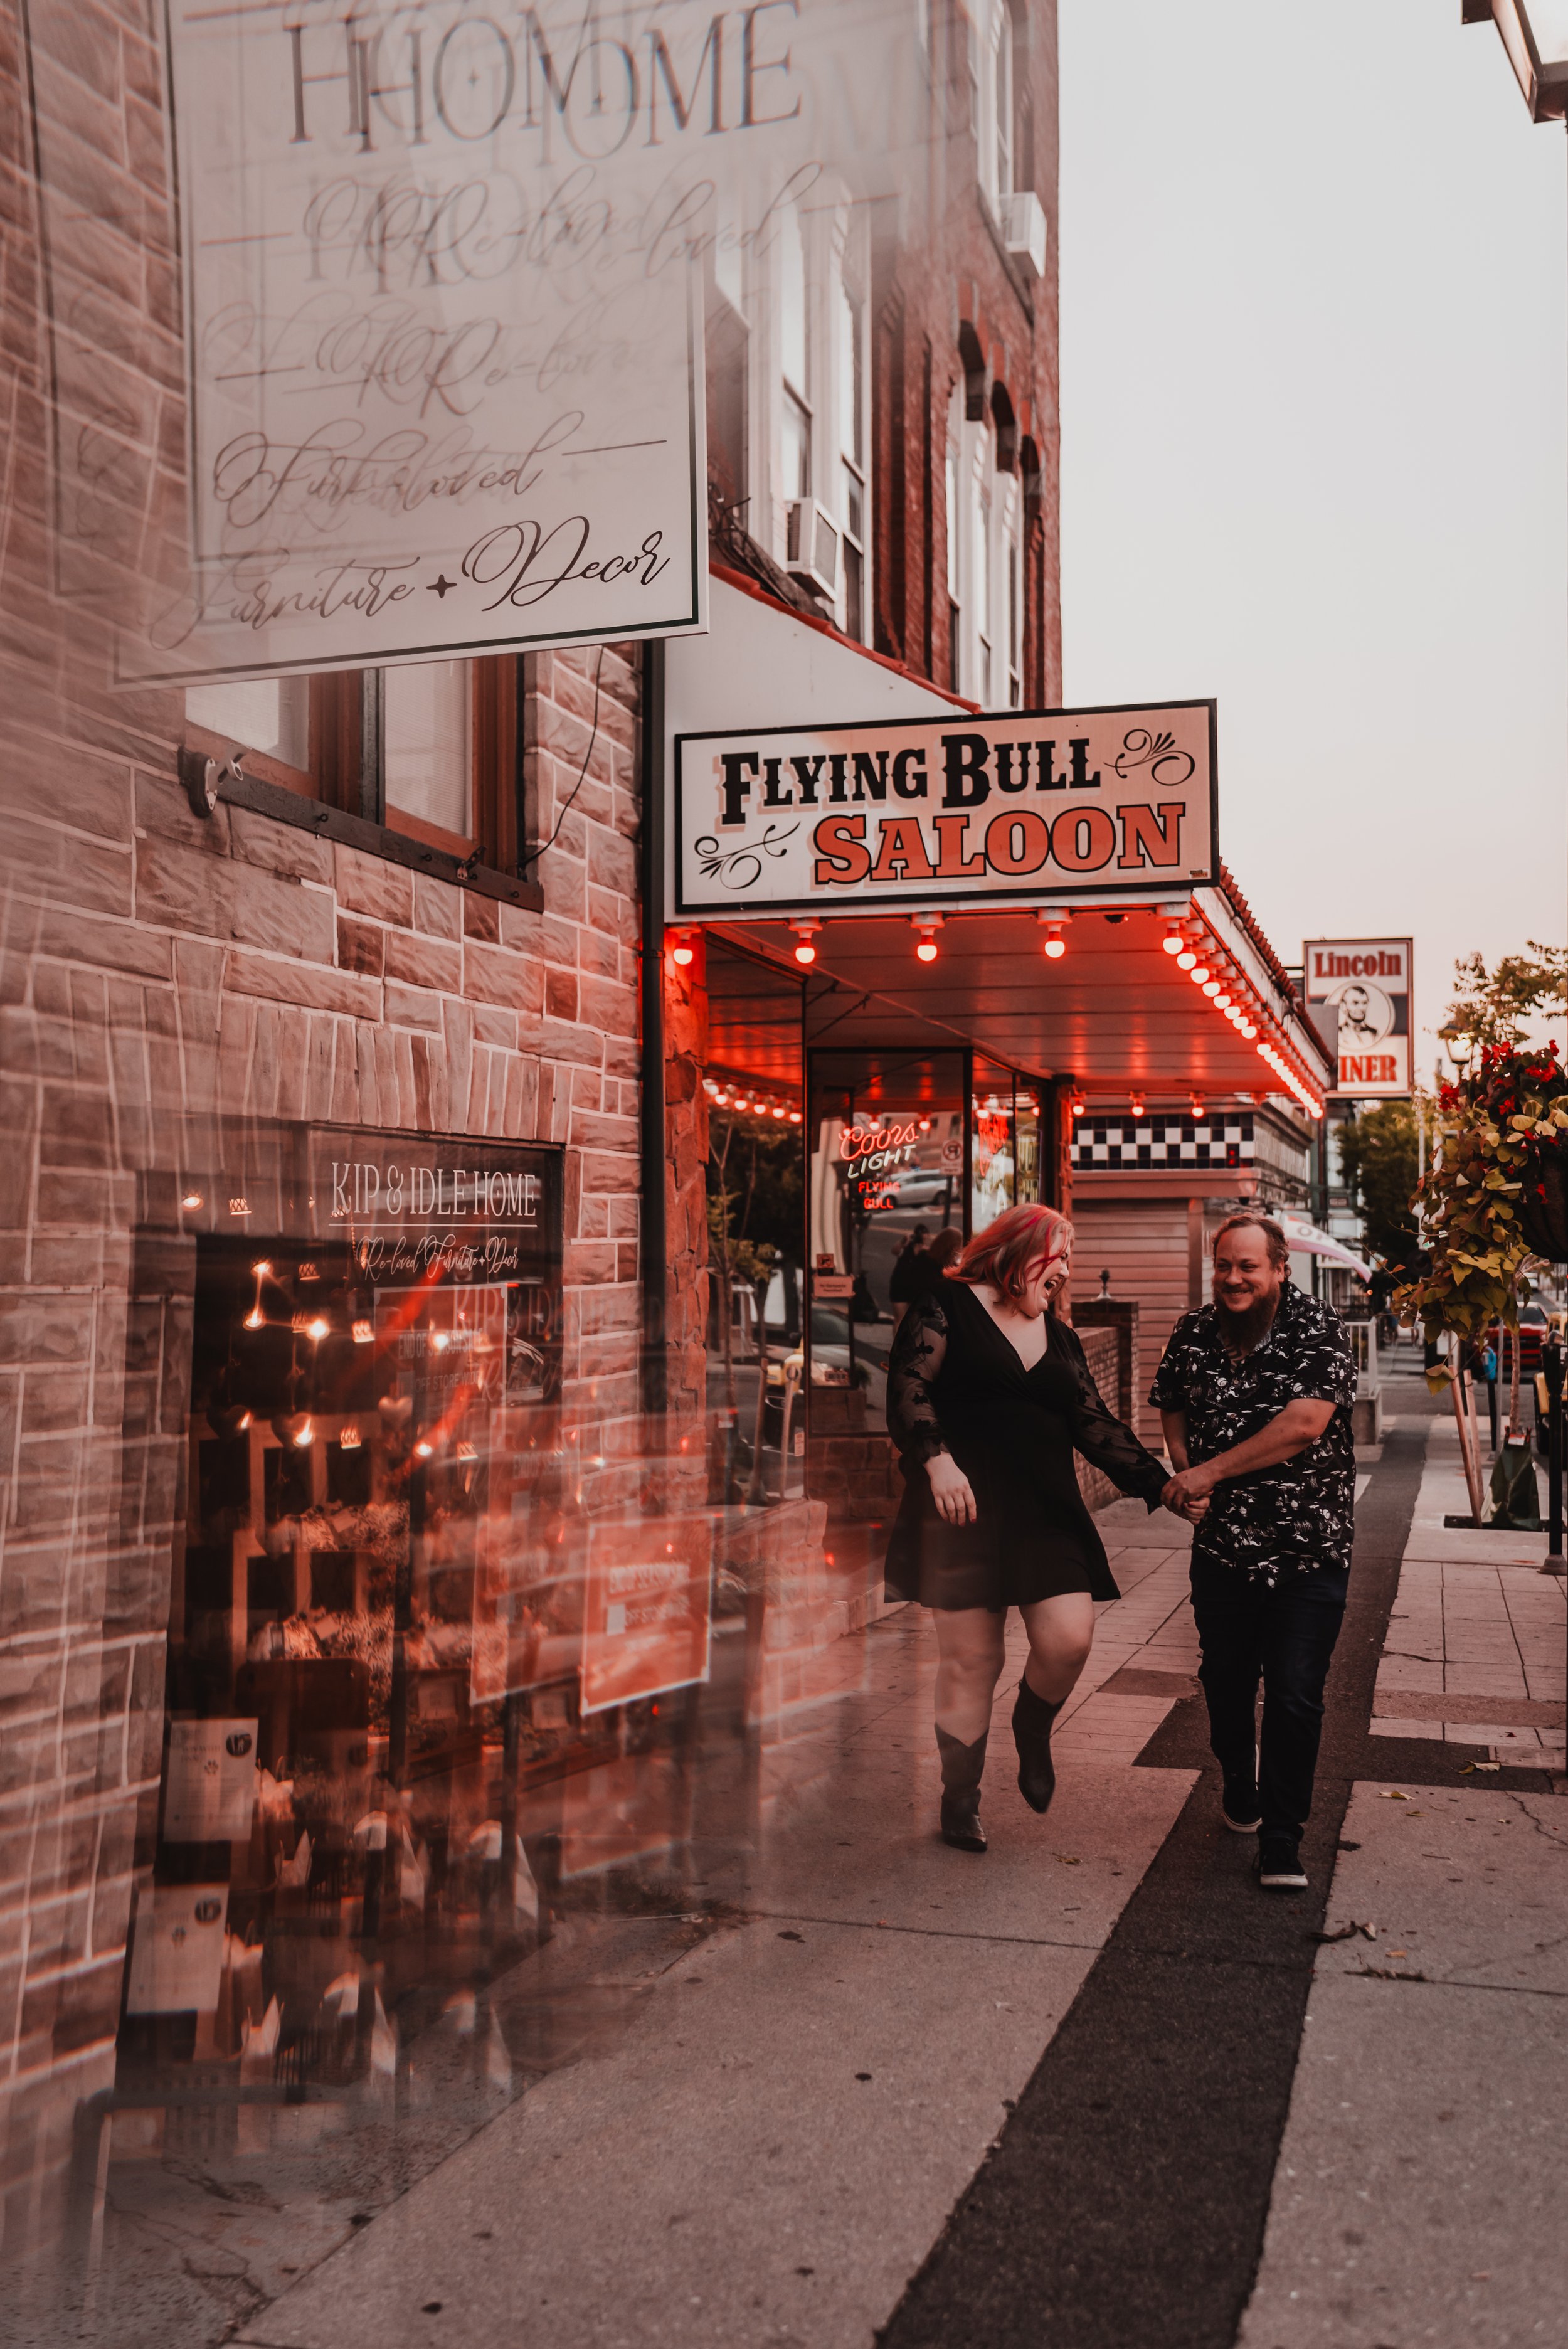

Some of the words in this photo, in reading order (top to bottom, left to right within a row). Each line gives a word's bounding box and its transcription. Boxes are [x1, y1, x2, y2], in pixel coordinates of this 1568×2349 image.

[461, 516, 670, 612] Decor
[721, 748, 928, 825] FLYING
[941, 733, 1101, 809] BULL
[815, 802, 1186, 886] SALOON
[1314, 950, 1402, 978] Lincoln
[1338, 1054, 1397, 1082] INER
[839, 1122, 919, 1160] Coors
[847, 1144, 917, 1179] LIGHT
[332, 1162, 380, 1214] KIP
[386, 1165, 404, 1215] &
[410, 1167, 467, 1215] IDLE
[474, 1170, 536, 1217] HOME
[858, 1181, 901, 1194] FLYING
